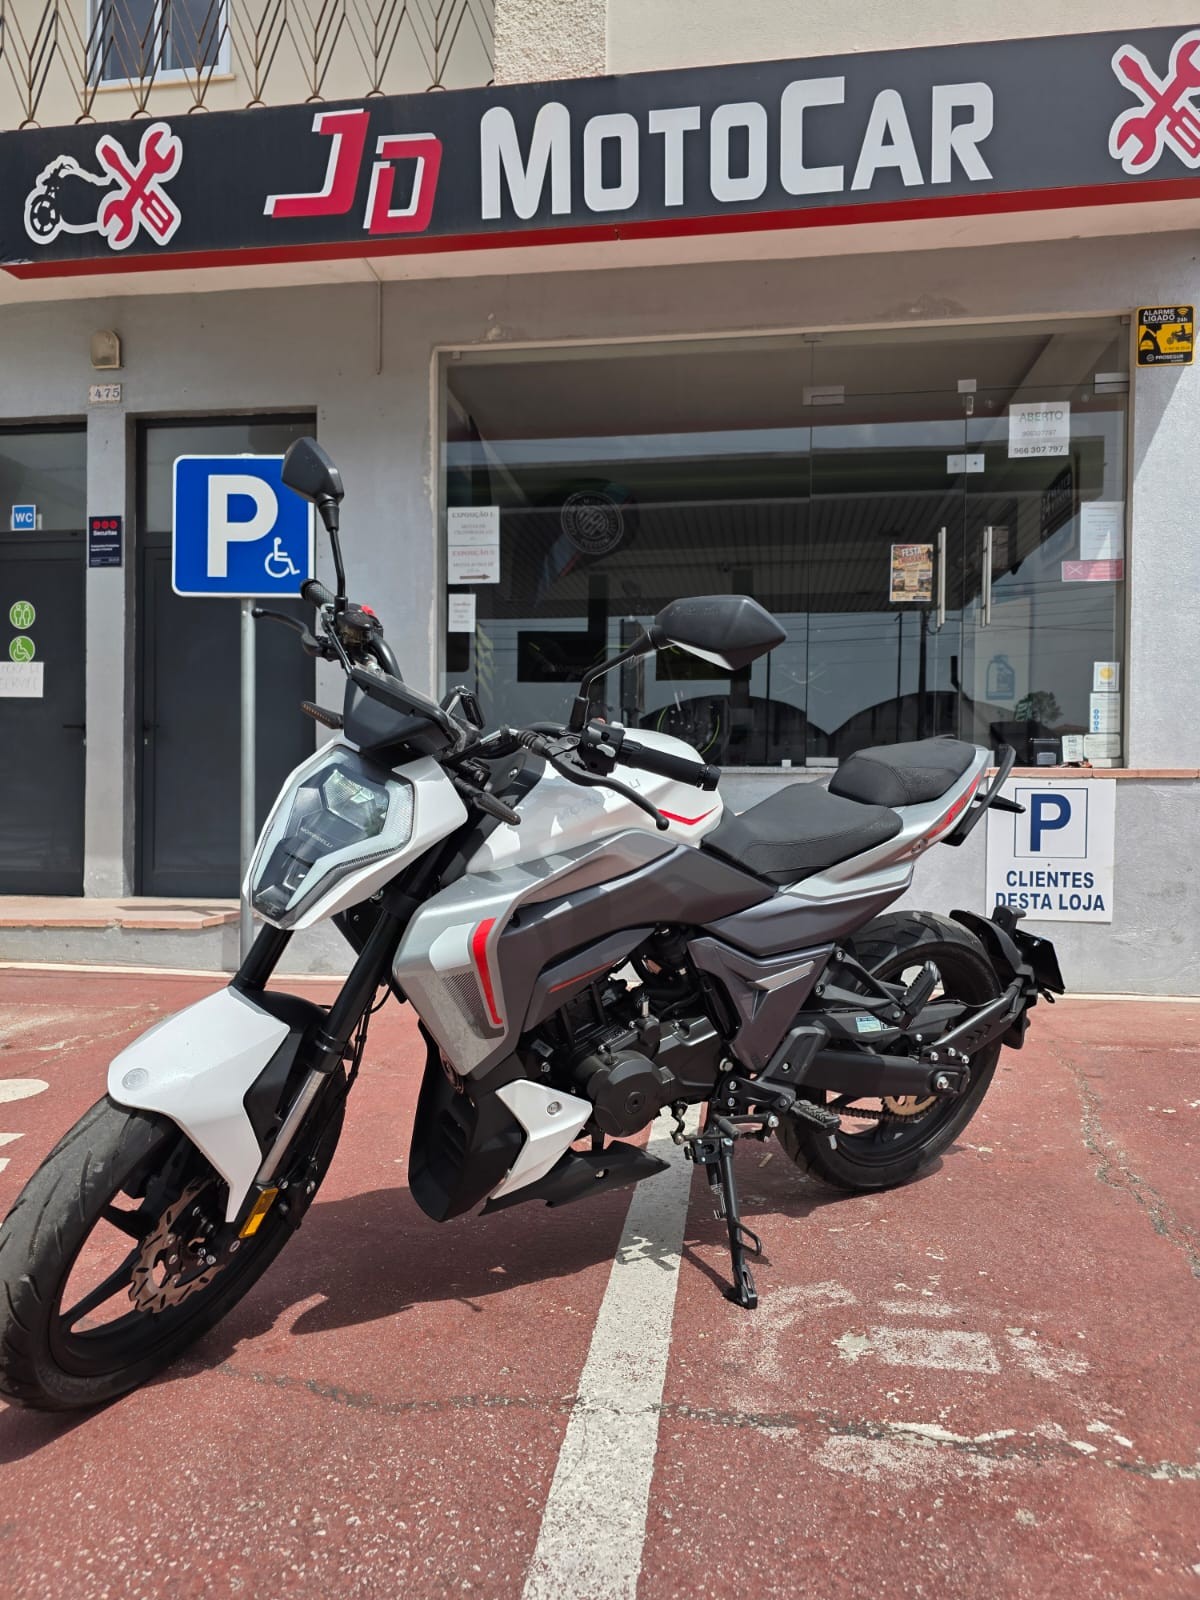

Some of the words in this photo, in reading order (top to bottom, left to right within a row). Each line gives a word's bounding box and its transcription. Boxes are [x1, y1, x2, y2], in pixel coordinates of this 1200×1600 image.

[263, 107, 443, 235] JD
[1143, 314, 1176, 322] LIGADO
[95, 387, 120, 399] 475
[1019, 410, 1064, 424] ABERTO
[15, 512, 33, 523] WC
[207, 474, 279, 578] P
[1029, 793, 1072, 852] P
[1006, 870, 1094, 889] CLIENTES
[995, 892, 1053, 910] DESTA
[1058, 893, 1105, 911] LOJA
